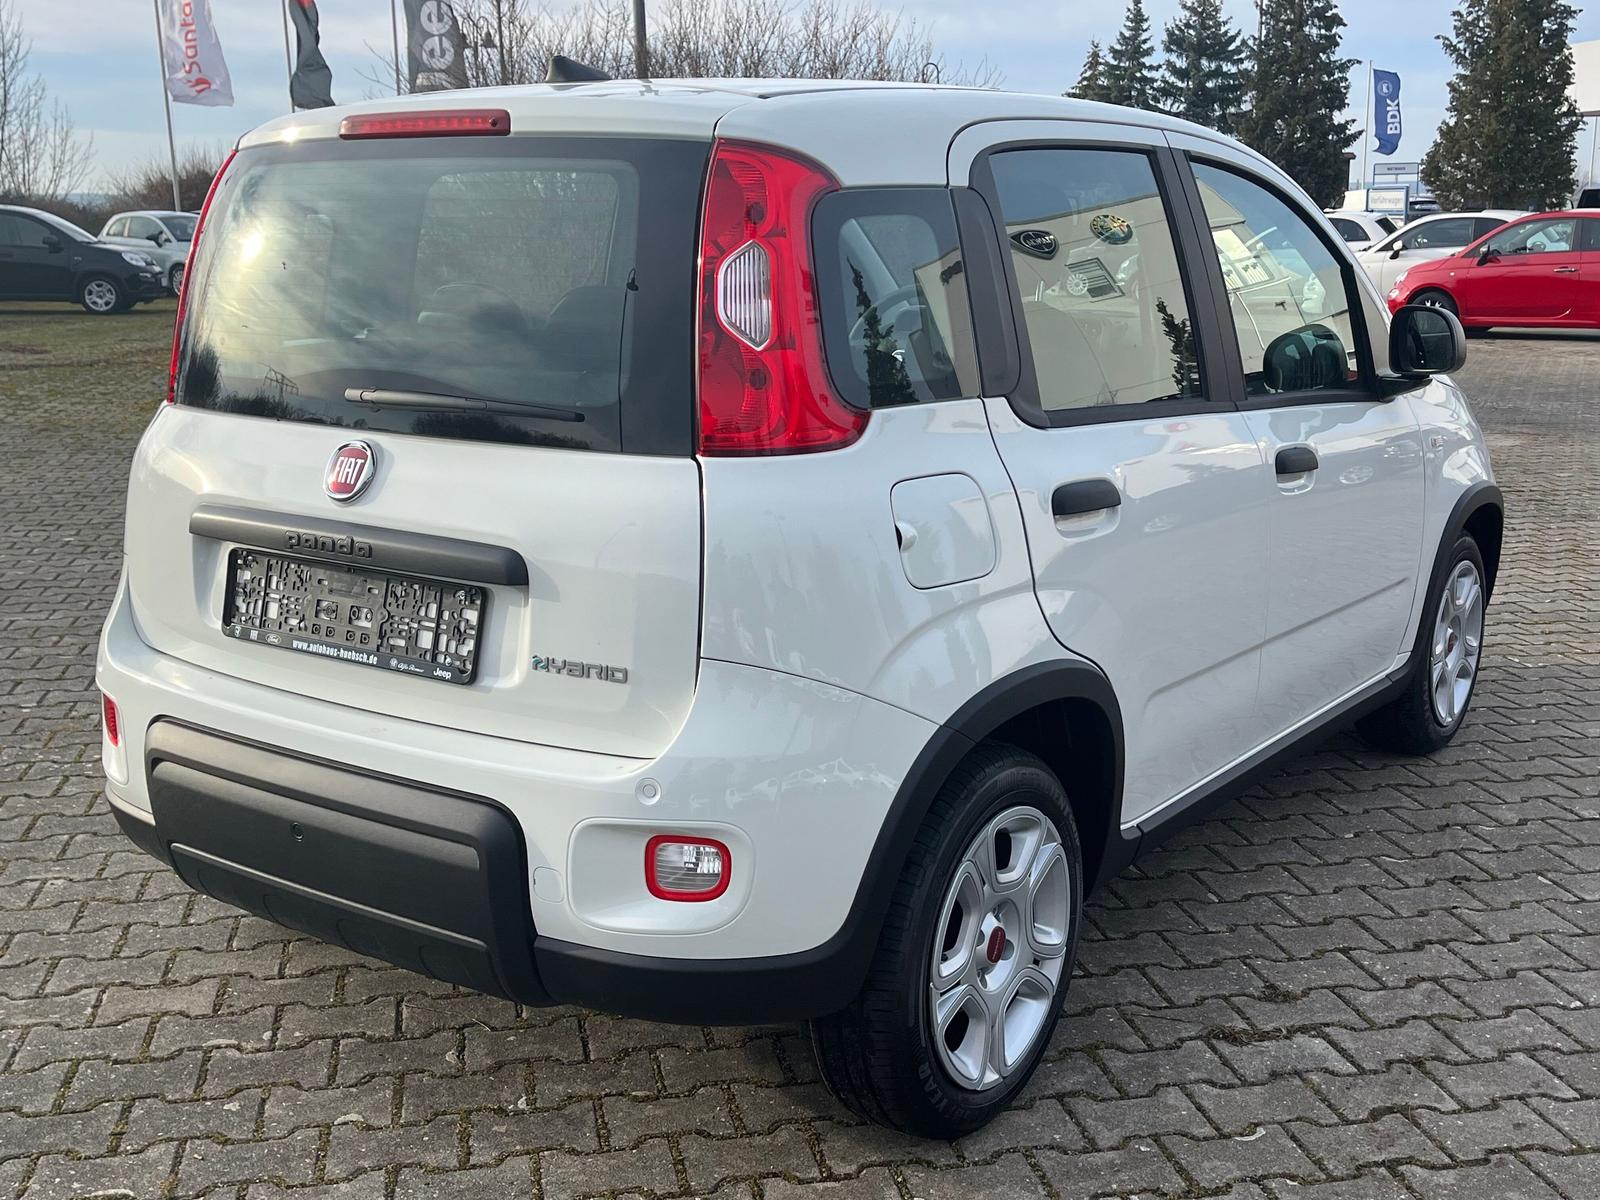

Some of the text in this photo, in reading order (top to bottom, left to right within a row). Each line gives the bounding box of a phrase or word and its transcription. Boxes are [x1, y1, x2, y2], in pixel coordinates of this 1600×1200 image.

[1386, 98, 1401, 135] BDK
[333, 456, 365, 485] FIAT
[284, 530, 373, 559] panda
[292, 640, 378, 665] www.autohaus-huebsch.de
[433, 667, 452, 680] Jeep
